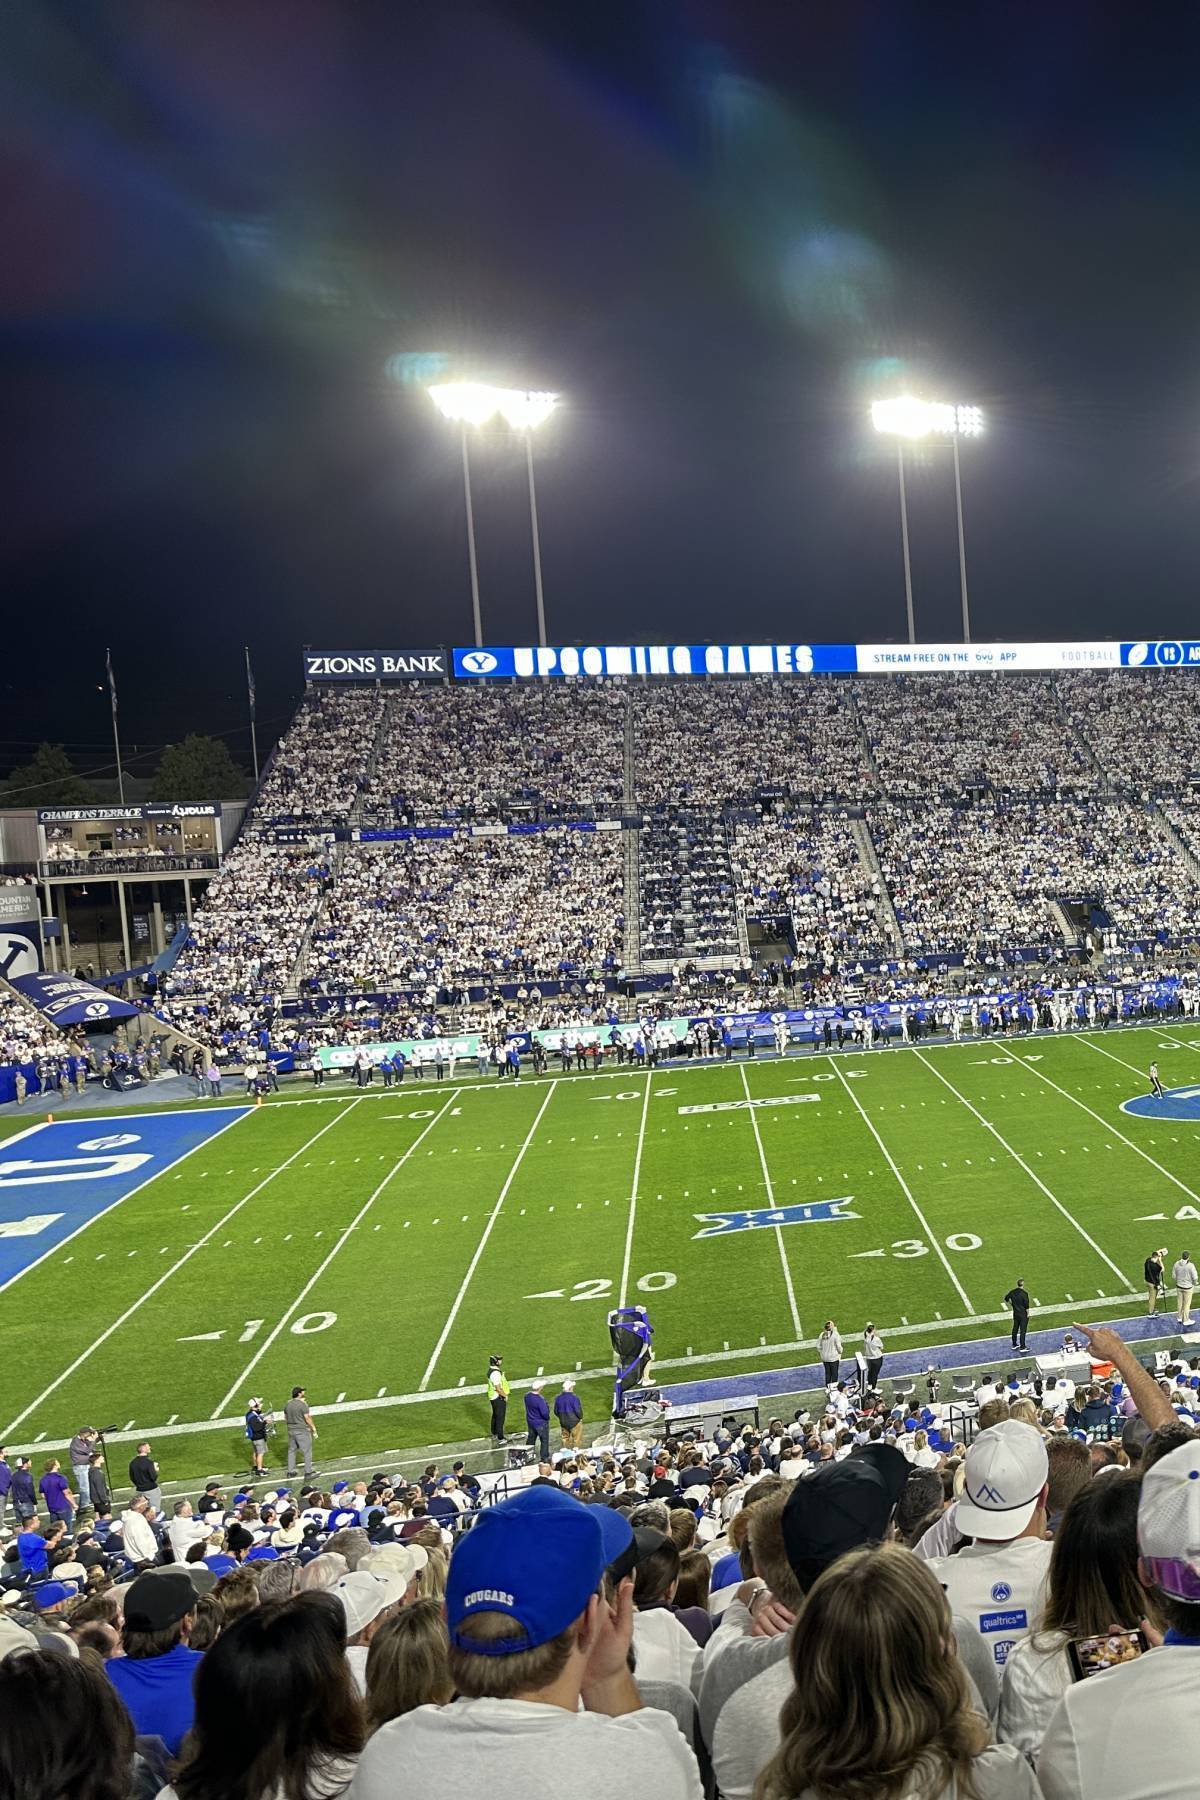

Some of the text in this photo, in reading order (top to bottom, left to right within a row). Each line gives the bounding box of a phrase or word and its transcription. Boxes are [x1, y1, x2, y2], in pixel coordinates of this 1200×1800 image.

[514, 645, 814, 676] UPCOMING GAMES
[874, 653, 911, 663] STREAM
[913, 653, 936, 662] FREE
[938, 652, 950, 662] ON
[950, 652, 969, 662] THE
[999, 652, 1017, 662] APP
[1062, 651, 1114, 661] FOOTBALL
[1163, 648, 1175, 661] VS
[307, 656, 444, 674] ZIONS BANK
[40, 810, 97, 820] CHAMPIONS
[98, 808, 142, 818] TERRACE
[0, 895, 31, 905] OUNTAIN
[0, 904, 30, 913] MERICA
[890, 1233, 983, 1259] 30
[570, 1271, 678, 1302] 20
[237, 1310, 338, 1343] 10
[465, 1589, 514, 1607] COUGARS
